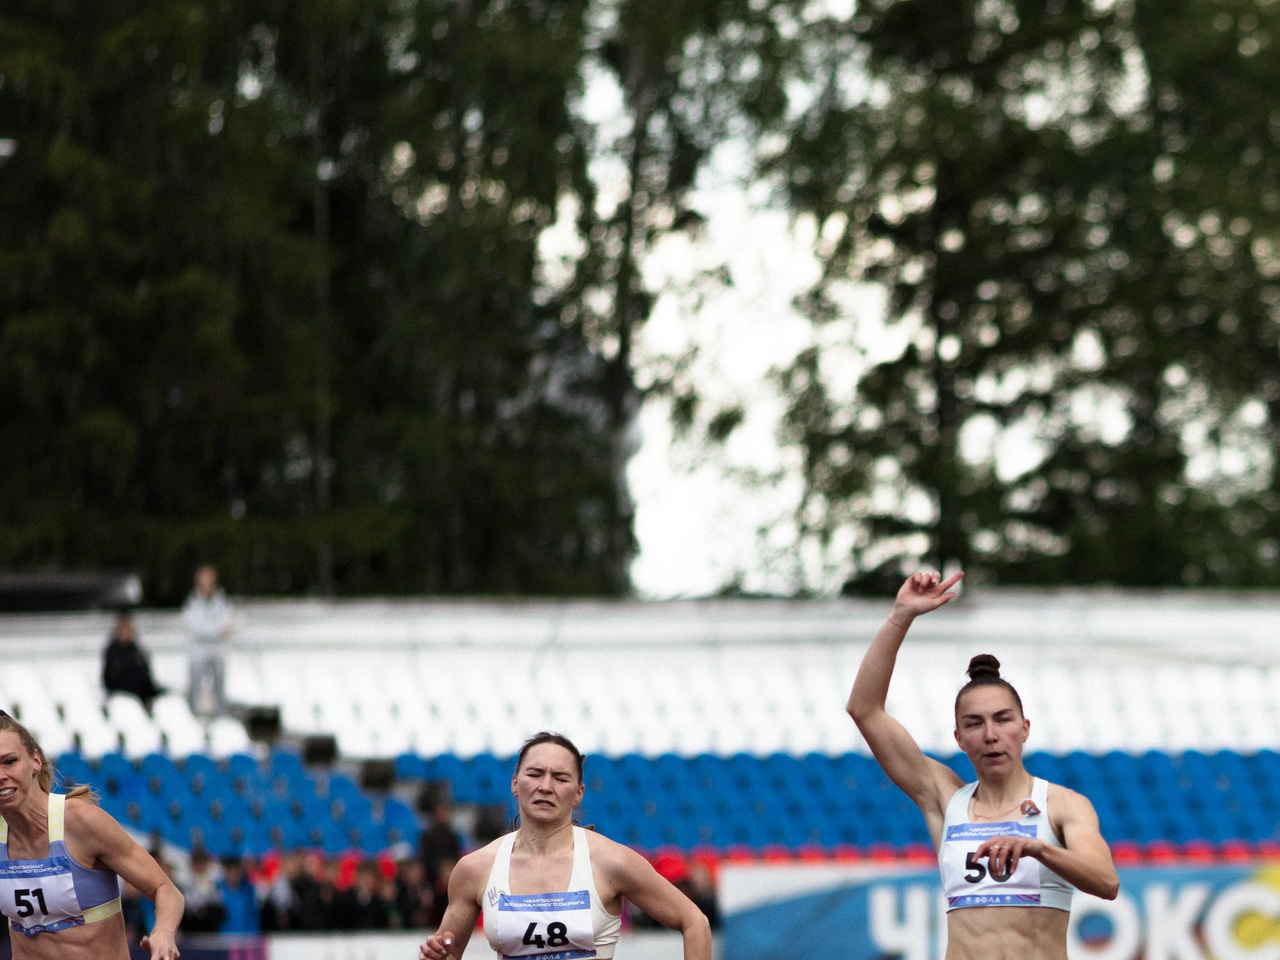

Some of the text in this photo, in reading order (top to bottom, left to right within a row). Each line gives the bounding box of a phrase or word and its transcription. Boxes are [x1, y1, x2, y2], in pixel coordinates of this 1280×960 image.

[964, 852, 1013, 882] 50
[14, 888, 49, 918] 51
[522, 922, 570, 949] 48
